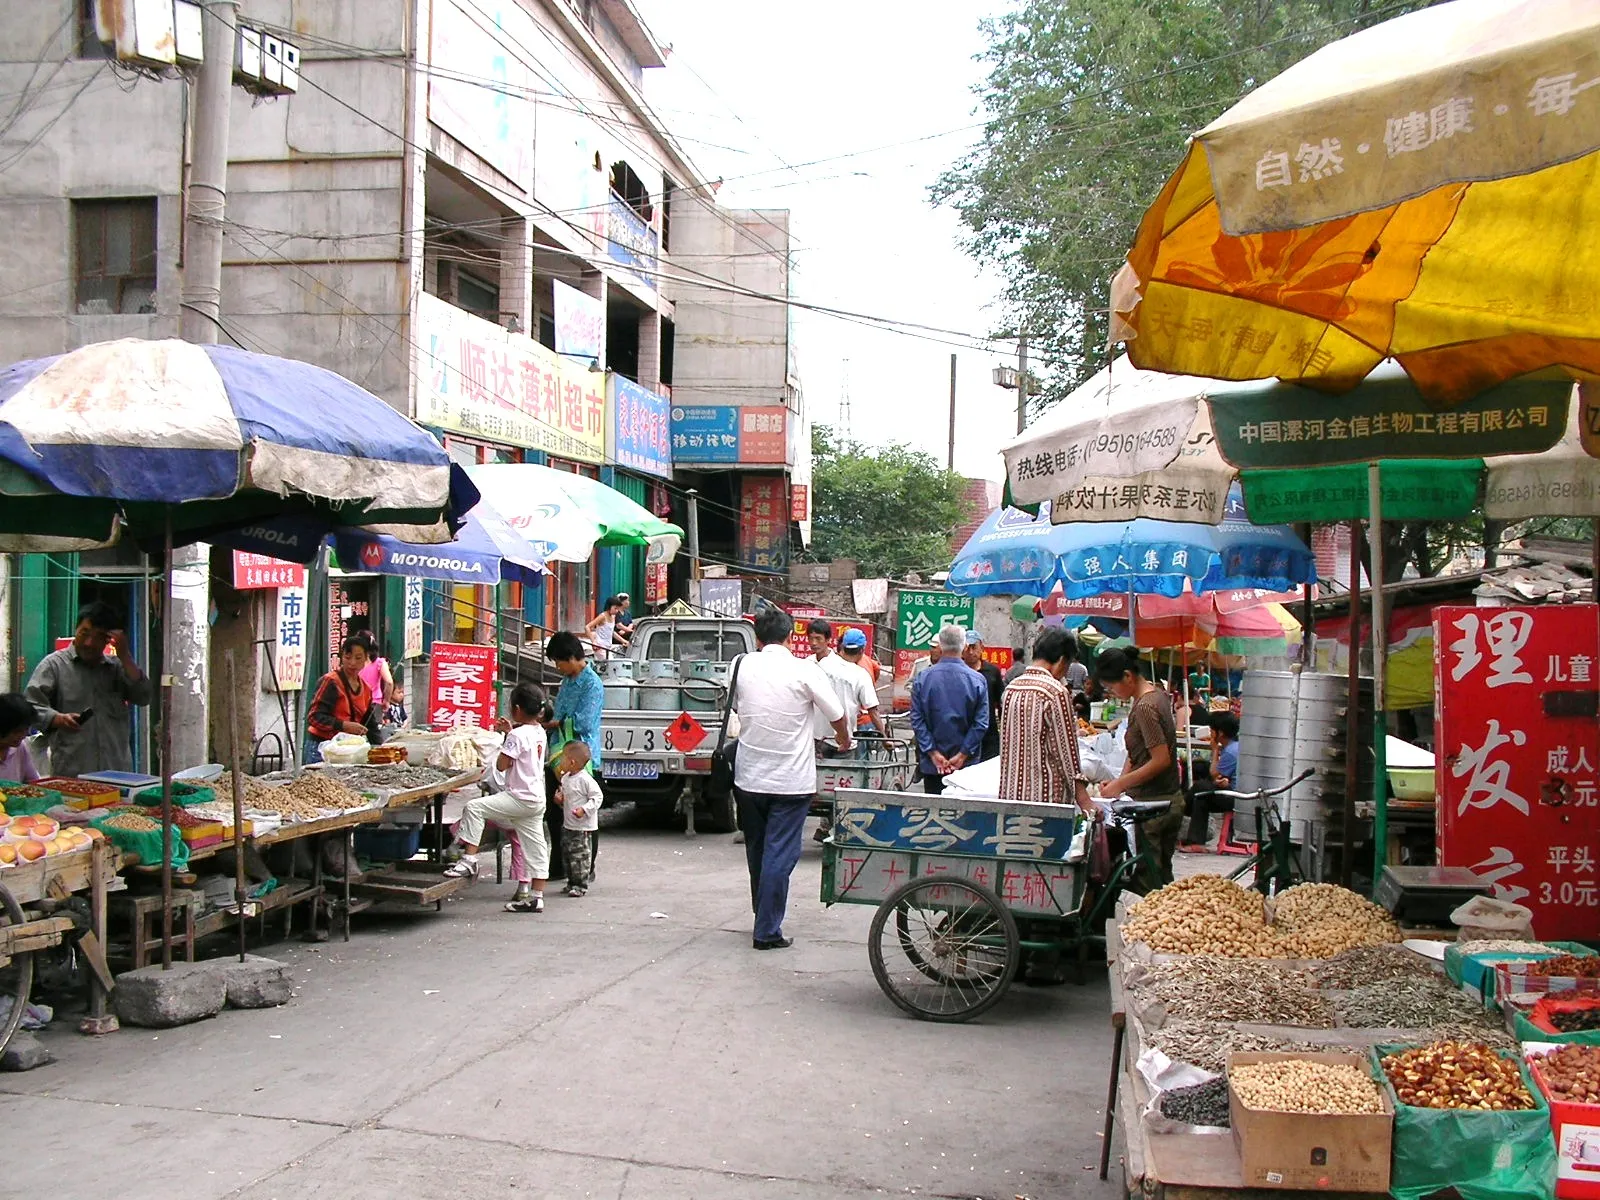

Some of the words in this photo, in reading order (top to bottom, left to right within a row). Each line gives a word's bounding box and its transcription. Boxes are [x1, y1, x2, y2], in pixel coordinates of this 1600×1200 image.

[459, 337, 605, 437] 顺达薄利超市
[743, 413, 783, 433] 服装店
[1238, 405, 1549, 445] 中国漯河金信生物工程有限公司
[673, 433, 737, 449] 移动话吧
[390, 552, 483, 574] MOTOROLA
[1083, 549, 1189, 576] 强人集团
[407, 577, 421, 620] 长途
[902, 593, 971, 609] 沙区冬云诊所
[280, 592, 303, 647] 市话
[1543, 654, 1592, 684] 儿童
[432, 661, 485, 731] 家电维
[1545, 745, 1595, 774] 成人
[1546, 845, 1596, 874] 平头
[1538, 880, 1599, 907] 3.0元
